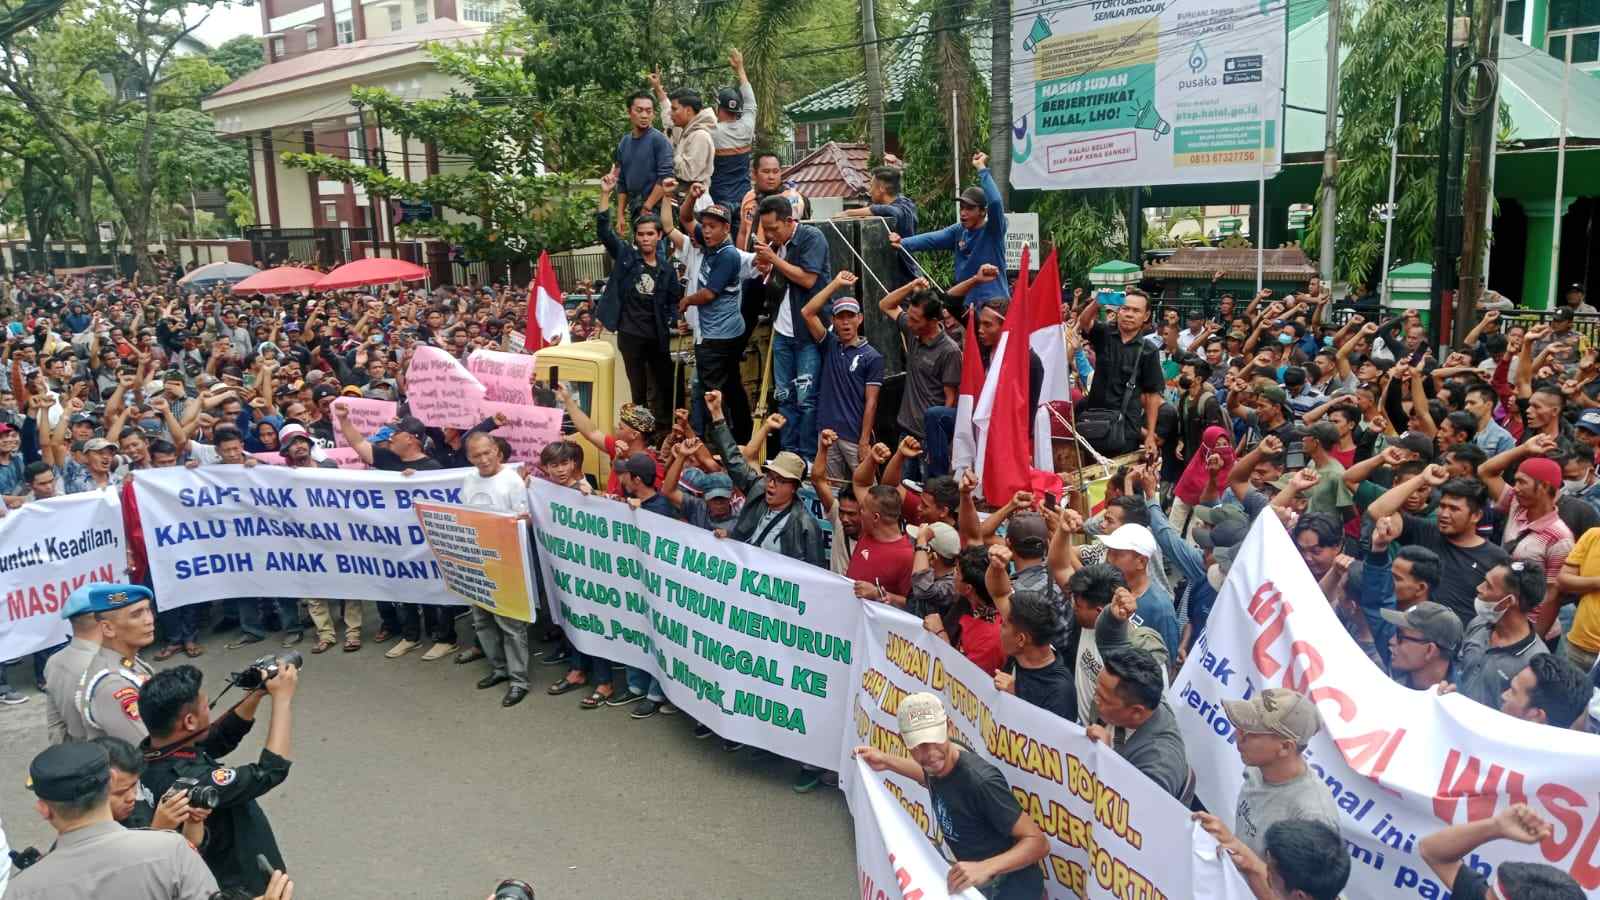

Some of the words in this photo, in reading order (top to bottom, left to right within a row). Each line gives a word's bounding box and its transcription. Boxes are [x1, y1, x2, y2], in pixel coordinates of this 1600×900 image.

[1093, 9, 1125, 22] SEMUA
[1125, 3, 1166, 17] PRODUK
[1042, 80, 1082, 98] HARUS
[1084, 73, 1129, 92] SUDAH
[1178, 76, 1217, 90] pusaka
[1042, 89, 1135, 113] BERSERTIFIKAT
[1042, 113, 1086, 128] HALAL,
[1089, 107, 1121, 122] LHO!
[250, 487, 297, 508] NAK
[307, 488, 386, 510] MAYOE
[46, 526, 118, 563] Keadilan,
[155, 519, 227, 548] KALU
[234, 517, 346, 541] MASAKAN
[350, 523, 403, 546] IKAN
[175, 552, 254, 580] SEDIH
[266, 552, 328, 573] ANAK
[337, 555, 381, 577] BINI
[550, 501, 609, 539] TOLONG
[654, 535, 680, 566] KE
[682, 547, 737, 586] NASIP
[740, 566, 807, 615] KAMI,
[589, 548, 613, 574] INI
[616, 556, 661, 597] SUAH
[665, 577, 725, 626] TURUN
[575, 576, 622, 609] KADO
[652, 608, 688, 649] KAMI
[691, 629, 785, 688] TINGGAL
[790, 664, 828, 699] KE
[886, 630, 930, 686] JANGAN
[1370, 813, 1416, 854] ini
